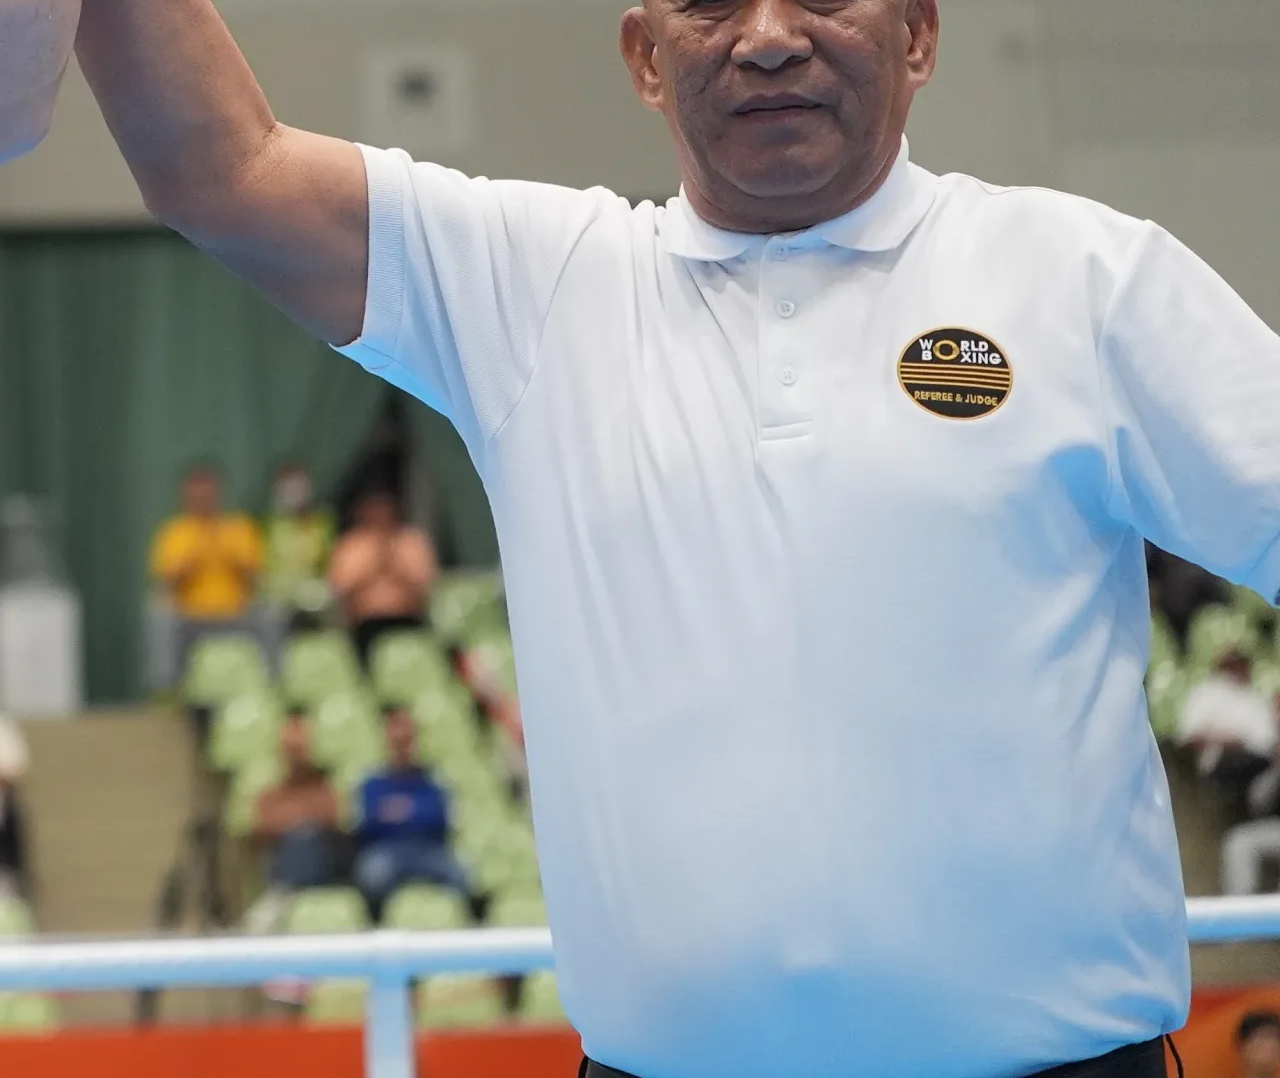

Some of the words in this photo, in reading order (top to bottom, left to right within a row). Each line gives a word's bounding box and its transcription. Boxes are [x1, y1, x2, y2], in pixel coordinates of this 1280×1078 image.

[914, 390, 953, 402] REFEREE
[955, 394, 963, 403] &
[965, 394, 998, 406] JUDGE
